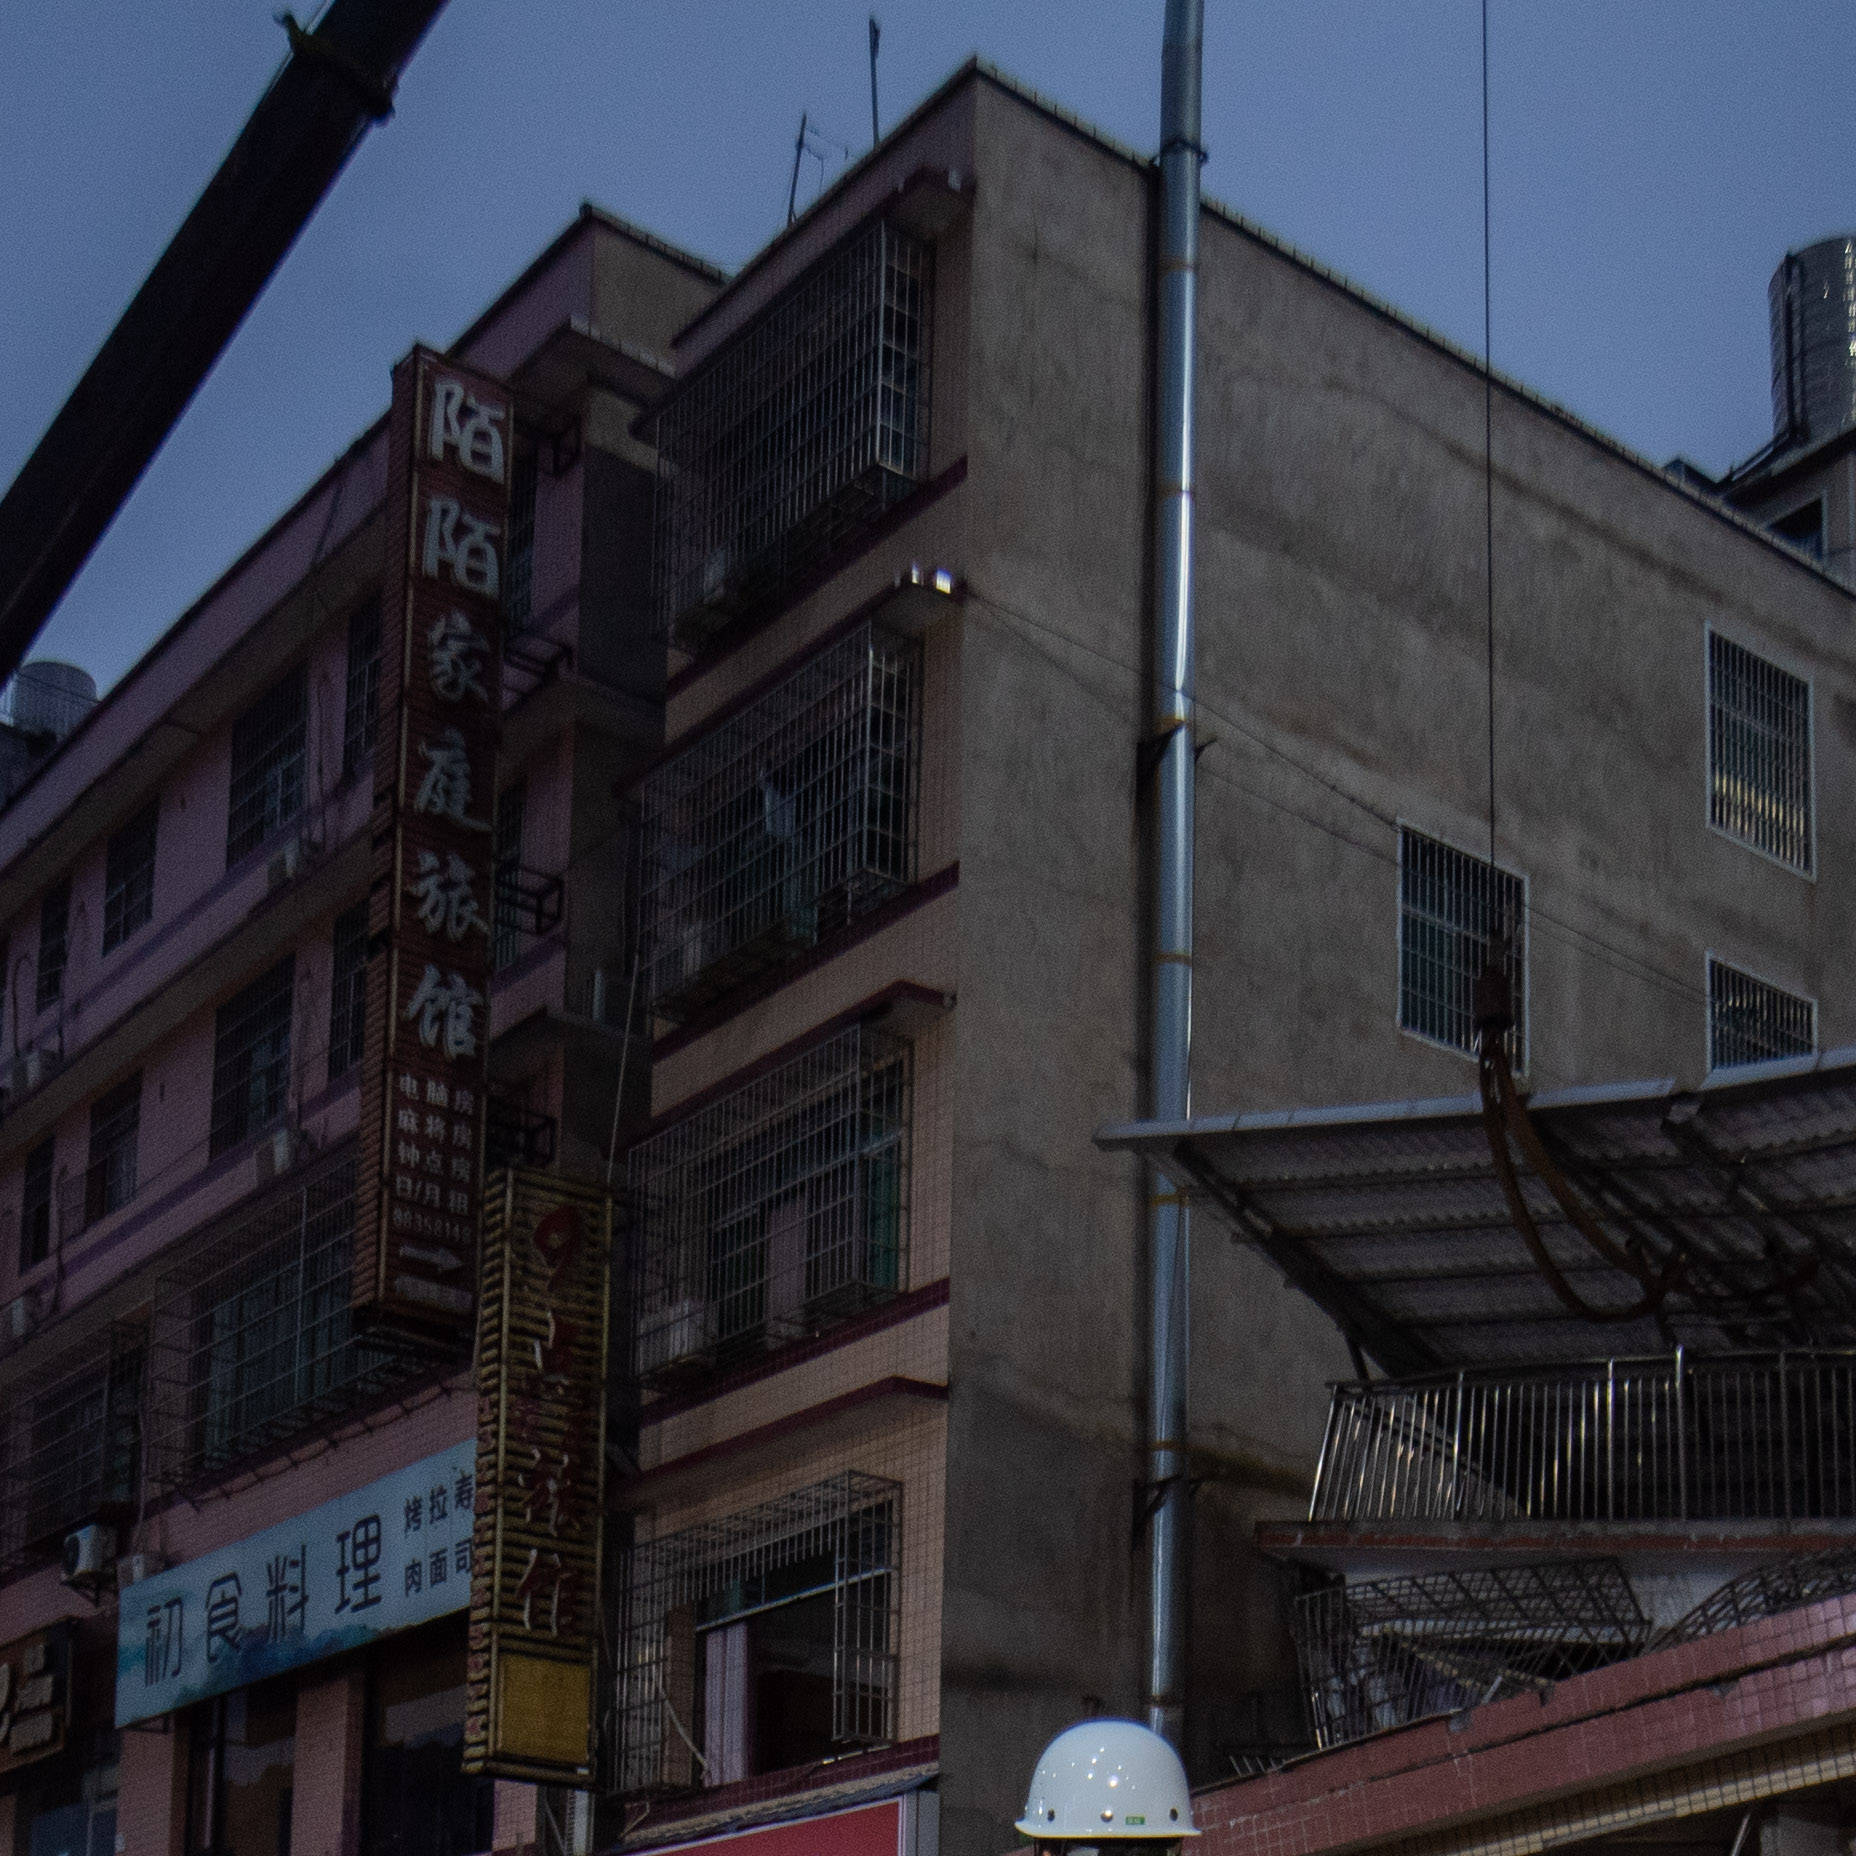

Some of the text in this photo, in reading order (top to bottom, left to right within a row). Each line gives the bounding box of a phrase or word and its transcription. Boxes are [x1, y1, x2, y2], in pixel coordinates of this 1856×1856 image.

[405, 381, 506, 1059] 陌陌家庭旅馆
[398, 1073, 475, 1117] 电脑房
[145, 1515, 382, 1687] 初食料理
[428, 1484, 449, 1589] 拉面
